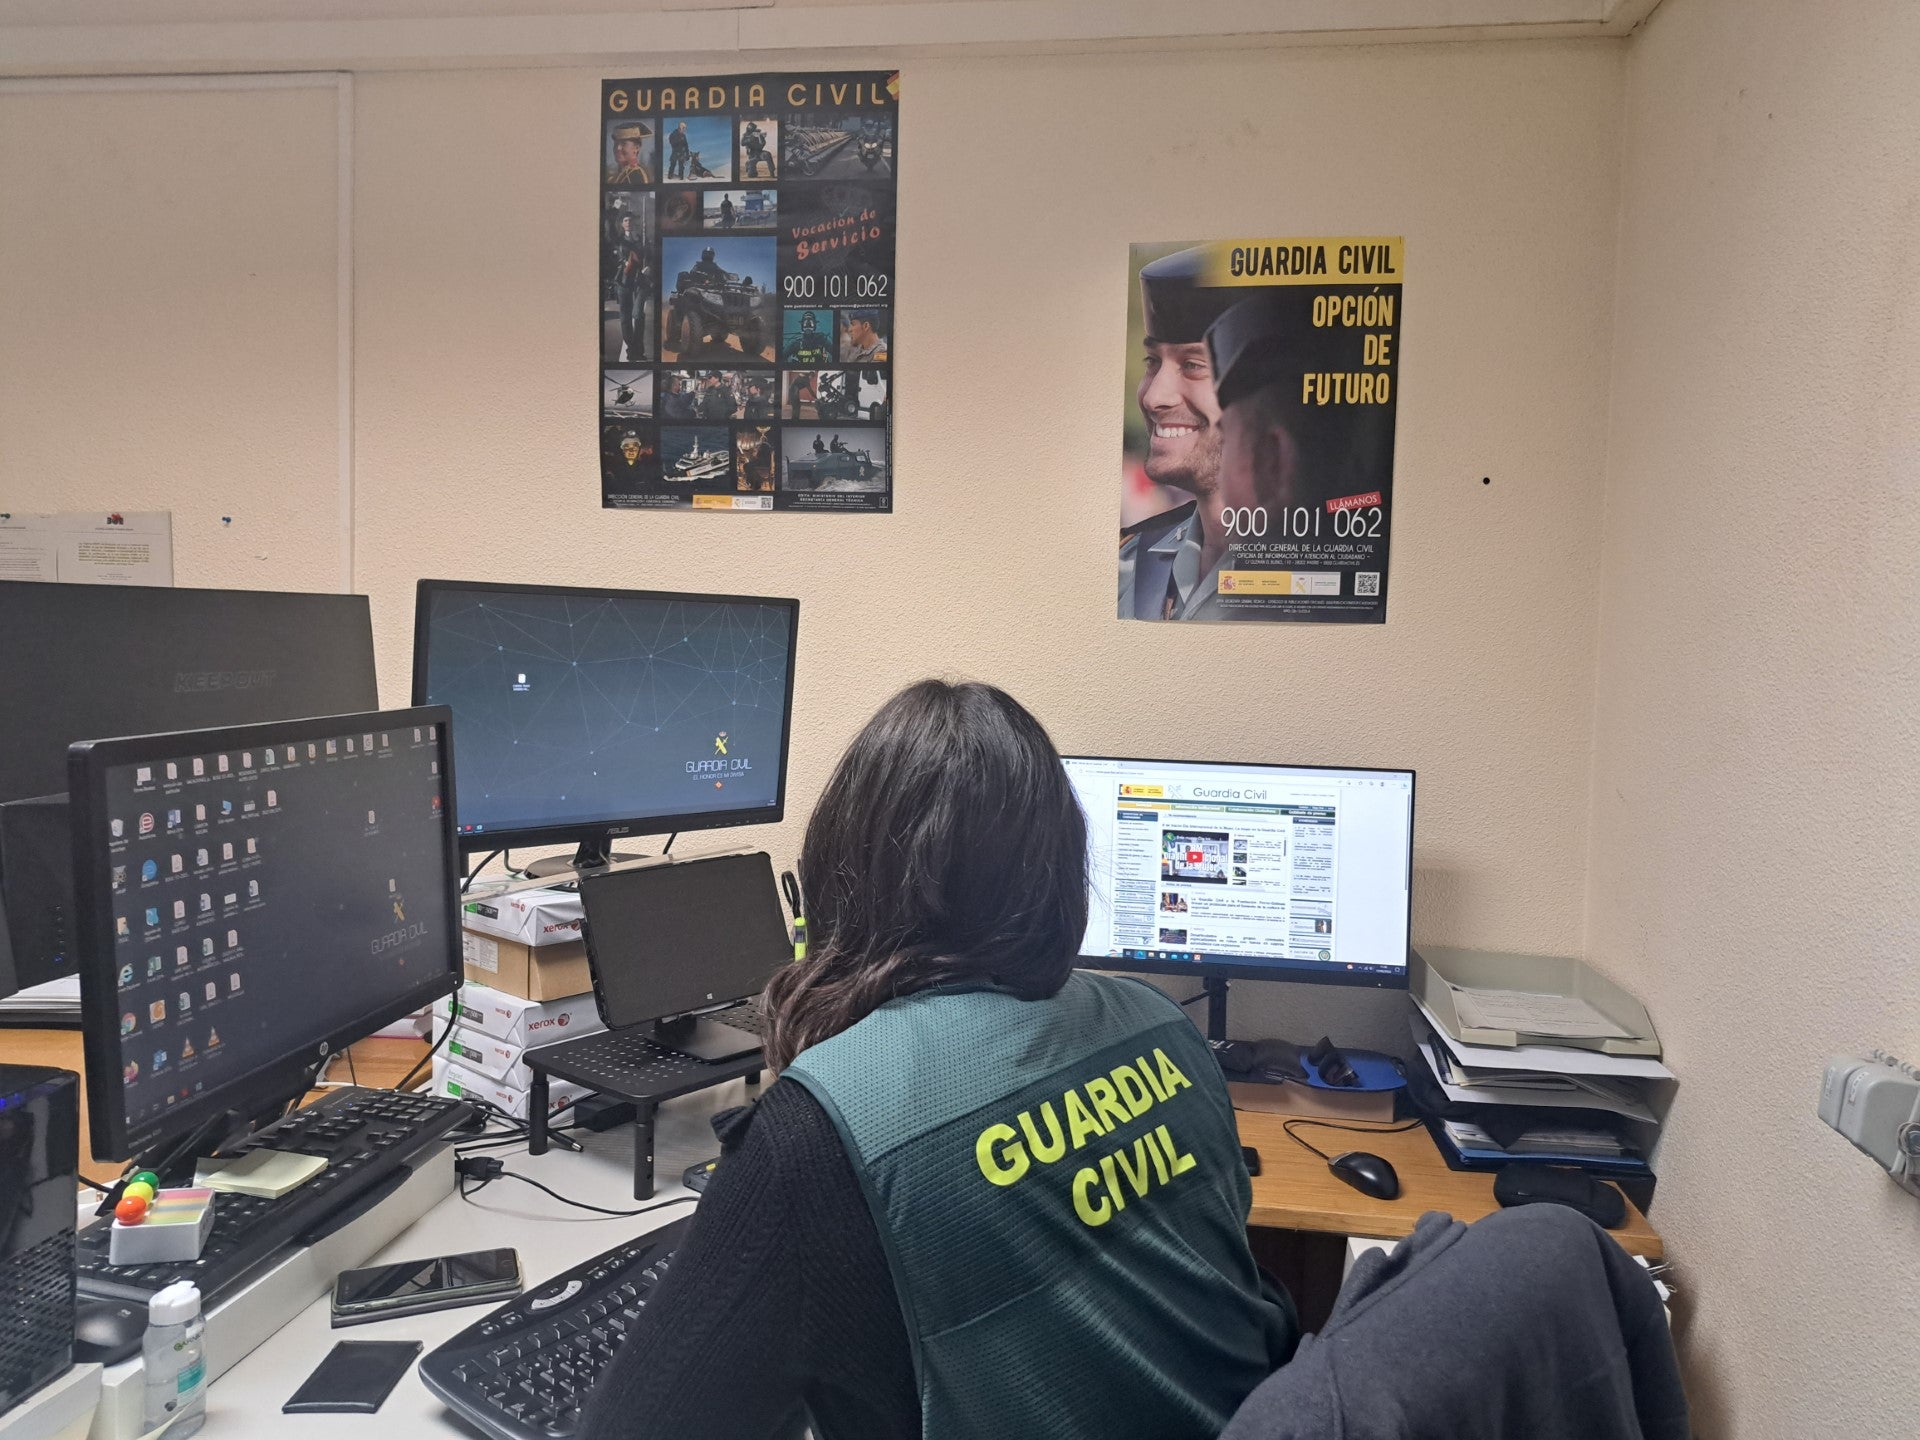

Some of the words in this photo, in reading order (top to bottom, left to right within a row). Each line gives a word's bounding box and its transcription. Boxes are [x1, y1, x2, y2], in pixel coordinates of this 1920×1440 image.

[609, 84, 765, 112] GUARDIA
[787, 83, 884, 107] CIVIL
[860, 209, 876, 222] de
[796, 226, 880, 260] Servicio
[1231, 246, 1327, 276] GUARDIA
[1339, 245, 1395, 274] CIVIL
[784, 275, 814, 298] 900
[824, 275, 848, 298] 101
[857, 275, 888, 297] 062
[1312, 287, 1394, 327] OPCIÓN
[1363, 334, 1392, 366] DE
[1302, 373, 1390, 406] FUTURO
[1329, 494, 1378, 511] LLÁMANOS
[1220, 507, 1268, 537] 900
[1283, 507, 1320, 537] 101
[1334, 507, 1382, 537] 062
[1229, 542, 1267, 552] DIRECCIÓN
[1270, 544, 1299, 552] GENERAL
[1302, 544, 1310, 552] DE
[1313, 544, 1321, 552] LA
[1323, 545, 1354, 553] GUARDIA
[1356, 545, 1374, 553] CIVIL
[1193, 787, 1240, 799] Guardia
[1244, 789, 1267, 800] Civil
[607, 827, 629, 835] ASUS
[543, 924, 568, 933] xerox
[528, 1018, 555, 1031] xerox
[976, 1047, 1193, 1186] GUARDIA
[1072, 1124, 1197, 1227] CIVIL
